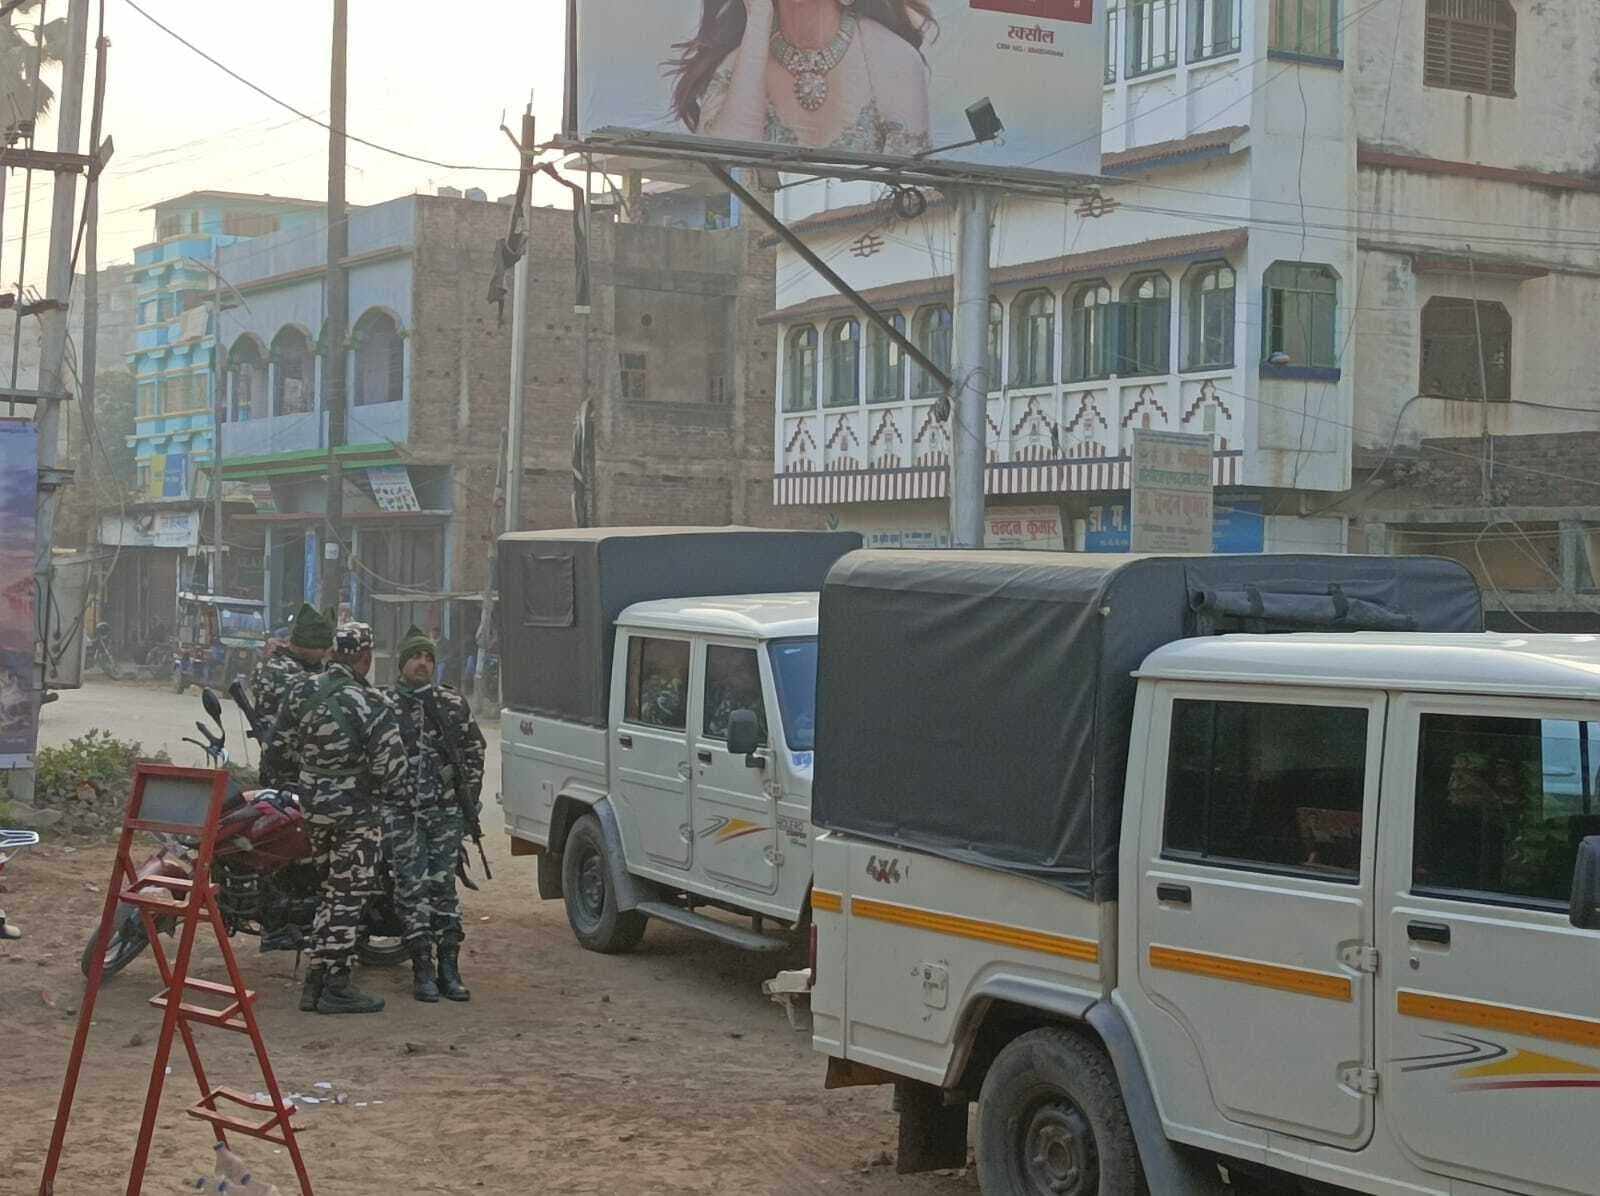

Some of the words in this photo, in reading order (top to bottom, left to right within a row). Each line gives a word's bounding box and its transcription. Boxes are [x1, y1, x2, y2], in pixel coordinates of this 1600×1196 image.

[1008, 24, 1055, 44] रक्सौल
[991, 520, 1022, 537] चन्दन
[1026, 520, 1058, 540] कुमार
